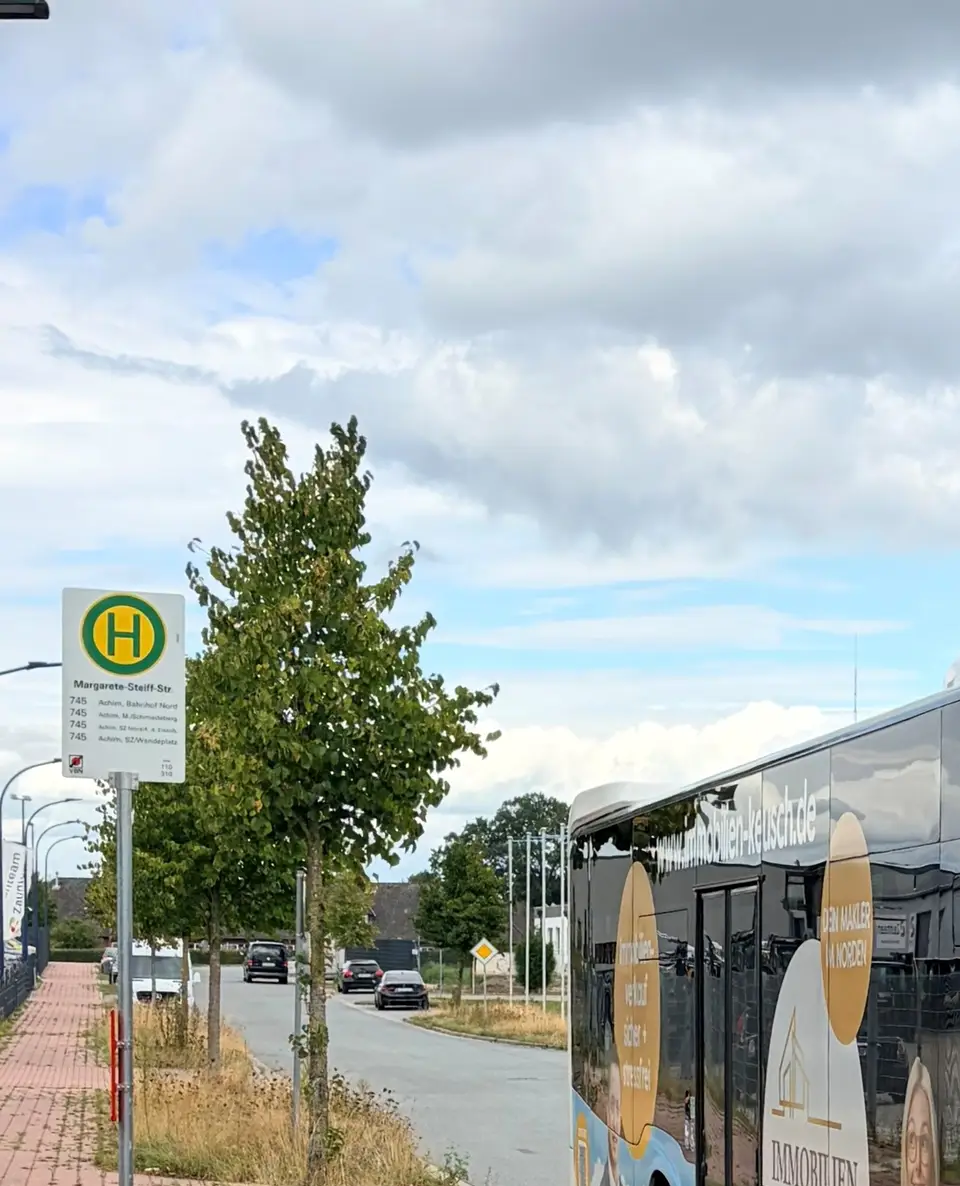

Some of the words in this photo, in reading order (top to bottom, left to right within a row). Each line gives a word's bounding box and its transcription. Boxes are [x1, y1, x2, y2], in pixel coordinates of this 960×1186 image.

[107, 612, 140, 658] H
[69, 696, 87, 705] 745
[69, 708, 87, 717] 745
[69, 720, 87, 729] 745
[69, 732, 87, 741] 745
[836, 940, 867, 969] NORDEN
